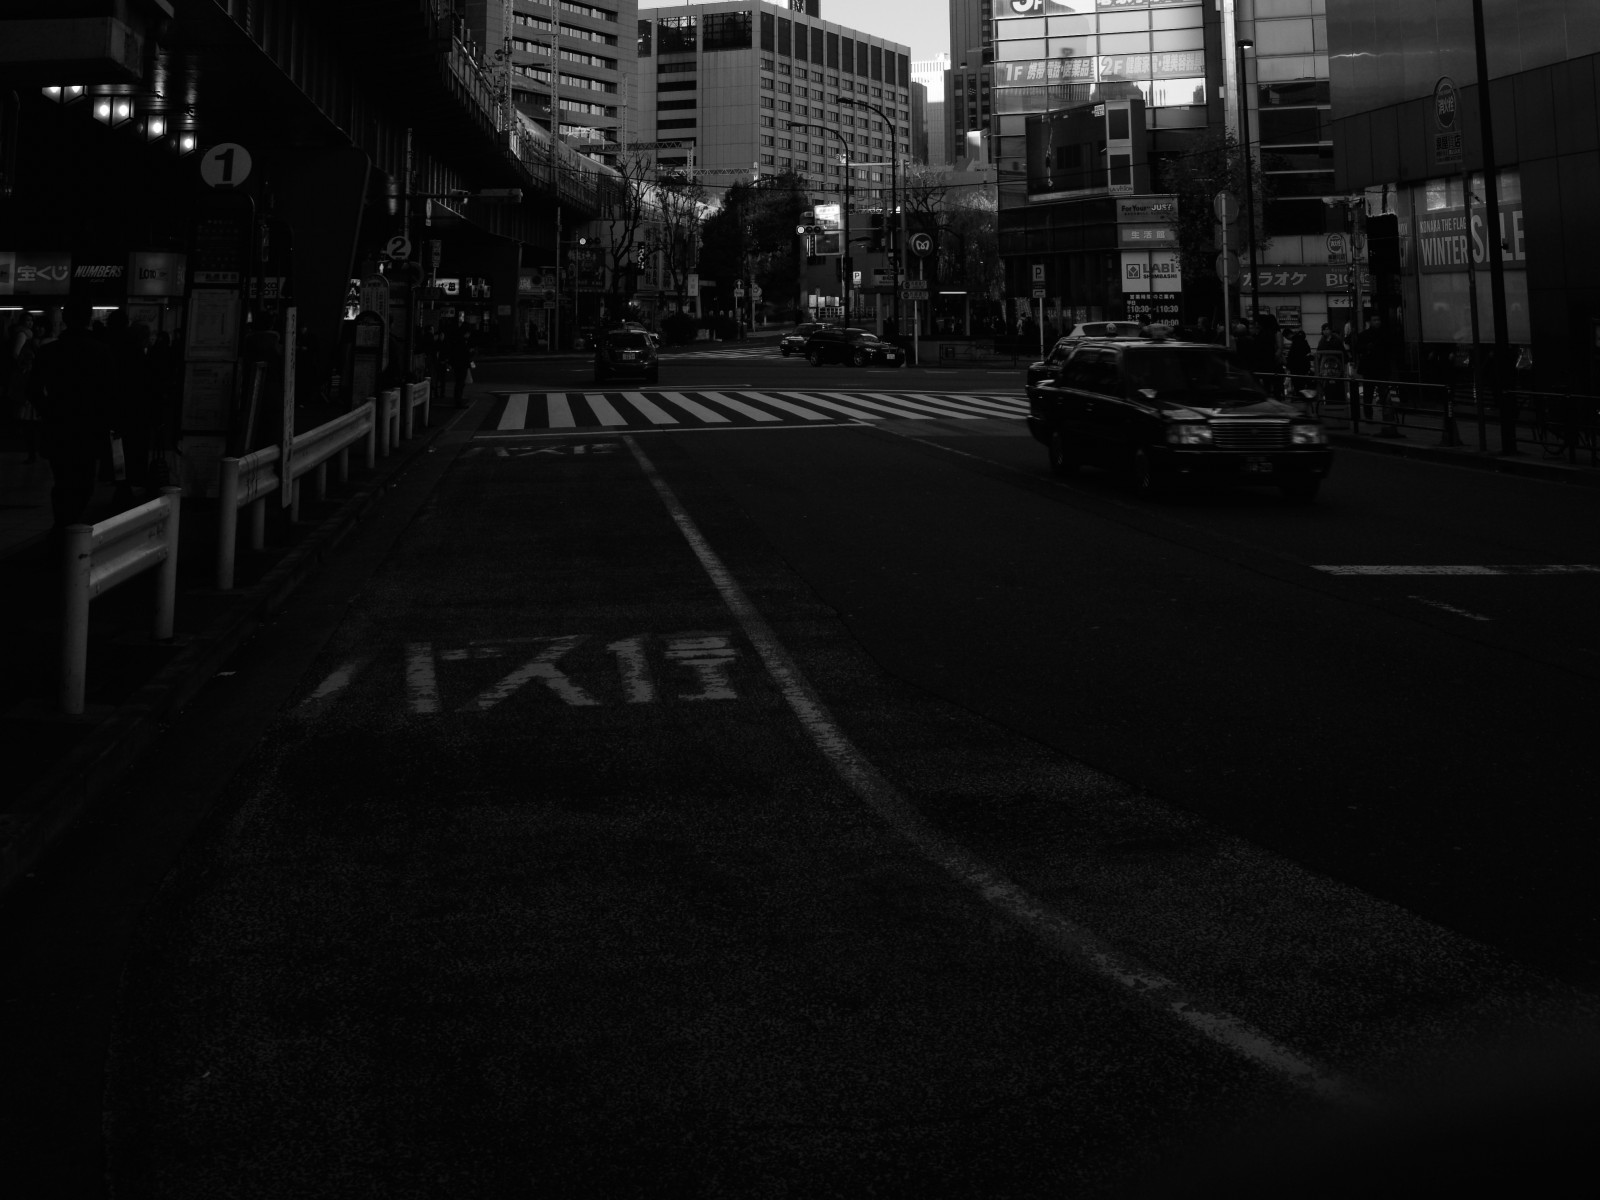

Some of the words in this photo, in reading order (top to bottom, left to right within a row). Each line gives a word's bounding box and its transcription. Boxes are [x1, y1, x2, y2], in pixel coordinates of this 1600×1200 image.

[1005, 63, 1023, 82] 1F
[1101, 56, 1124, 76] 2F
[214, 148, 234, 182] 1
[1441, 217, 1452, 231] THE
[1452, 216, 1467, 230] FLAG
[391, 239, 406, 256] 2
[1420, 235, 1469, 267] WINTER
[17, 264, 69, 282] 宝くじ
[74, 264, 125, 279] NUMBERS
[1035, 267, 1042, 279] P
[1242, 271, 1307, 287] カラオケ
